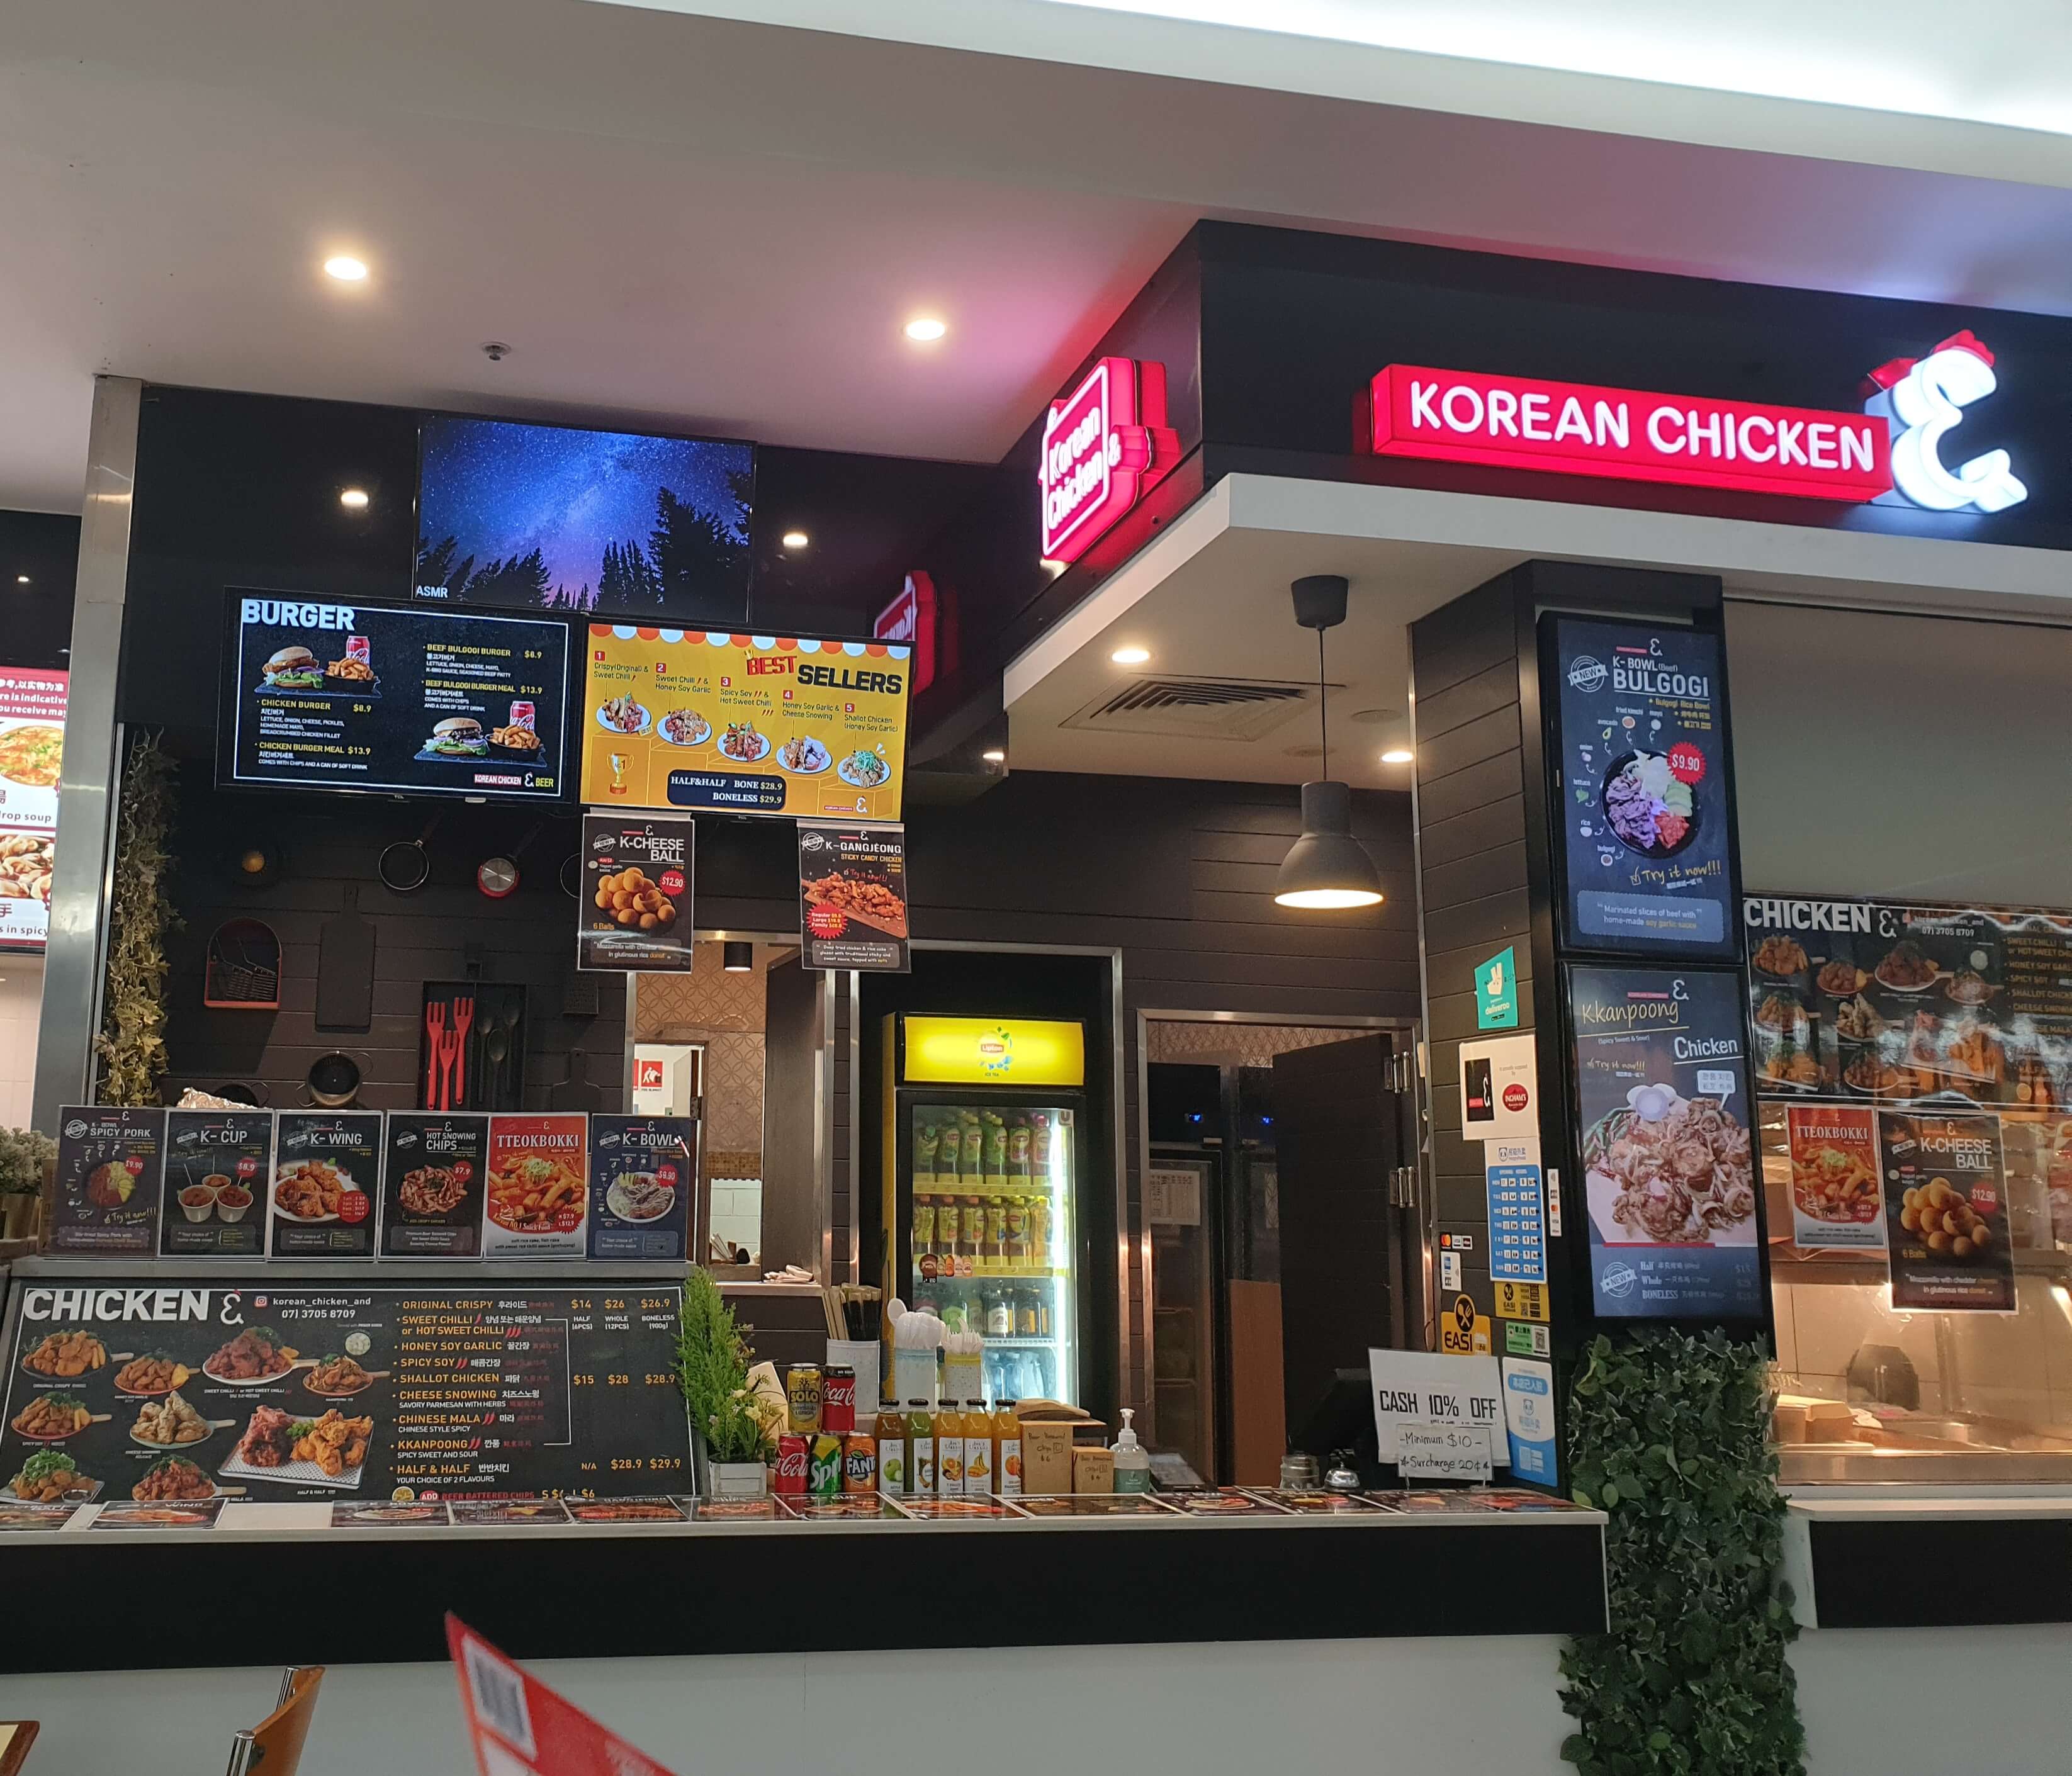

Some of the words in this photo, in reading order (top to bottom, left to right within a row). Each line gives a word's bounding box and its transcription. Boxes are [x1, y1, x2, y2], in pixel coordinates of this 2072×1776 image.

[1411, 381, 1630, 448] KOREAN
[1647, 407, 1874, 473] CHICKEN
[1049, 407, 1100, 485] Korean
[1047, 451, 1102, 529] Chicken
[415, 585, 448, 598] ASMR
[242, 600, 355, 631] BURGER
[448, 646, 480, 654] BULGOGI
[481, 648, 511, 656] BURGER
[524, 650, 542, 659] $8.9
[1628, 658, 1658, 671] BOWL
[746, 655, 797, 675] BEST
[797, 665, 902, 695] SELLERS
[443, 681, 470, 689] BULGOGI
[471, 683, 497, 691] BURGER
[521, 685, 543, 694] $13.9
[1613, 669, 1708, 697] BULGOGI
[678, 685, 690, 693] Soy
[720, 688, 738, 697] Spicy
[12, 705, 47, 714] receive
[262, 699, 296, 707] CHICKEN
[298, 702, 330, 710] BURGER
[353, 704, 371, 712] $8.9
[806, 712, 832, 720] Snowing
[259, 742, 291, 750] CHICKEN
[293, 744, 323, 752] BURGER
[347, 746, 371, 755] $13.9
[1672, 755, 1699, 771] $9.90
[536, 778, 553, 787] BEER
[670, 775, 726, 787] HALF&HALF
[734, 780, 759, 789] BONE
[760, 781, 782, 791] $28.9
[712, 792, 758, 803] BONELESS
[760, 794, 782, 804] $29.9
[25, 814, 51, 823] soup
[620, 836, 684, 851] K-CHEESE
[826, 841, 901, 853] K-GANGJEONG
[651, 851, 684, 862] BALL
[662, 877, 684, 888] $12.90
[1641, 870, 1665, 884] Try
[1743, 899, 1871, 933] CHICKEN
[7, 925, 16, 933] in
[21, 926, 48, 936] spicy
[1582, 1001, 1679, 1028] Kkanpoong
[1674, 1037, 1738, 1059] Chicken
[90, 1128, 120, 1137] SPICY
[125, 1128, 151, 1137] PORK
[221, 1131, 247, 1143] CUP
[1795, 1126, 1869, 1140] TTEOKBOKKI
[329, 1133, 363, 1145] WING
[497, 1135, 580, 1148] TTEOKBOKKI
[640, 1135, 675, 1146] BOWL
[426, 1140, 458, 1150] CHIPS
[1920, 1138, 1992, 1154] K-CHEESE
[1956, 1155, 1993, 1169] BALL
[455, 1166, 470, 1176] $7.9
[24, 1289, 210, 1321] CHICKEN
[273, 1297, 371, 1307] korean_chicken_and
[403, 1301, 453, 1309] ORIGINAL
[456, 1301, 493, 1309] CRISPY
[498, 1300, 527, 1309] 후라이드
[571, 1299, 591, 1309] $14
[605, 1299, 624, 1309] $26
[641, 1298, 670, 1309] $26.9
[301, 1309, 327, 1319] 3705
[330, 1309, 356, 1318] 8709
[402, 1315, 437, 1324] SWEET
[440, 1315, 473, 1324] CHILLI
[485, 1315, 499, 1324] 양념
[500, 1315, 514, 1324] 또는
[515, 1315, 541, 1324] 매운양념
[417, 1327, 436, 1335] HOT
[438, 1327, 471, 1335] SWEET
[402, 1342, 438, 1351] HONEY
[441, 1342, 461, 1351] SOY
[464, 1342, 502, 1350] GARLIC
[507, 1342, 529, 1350] 꿀간장
[1445, 1332, 1472, 1351] EASI
[401, 1358, 432, 1366] SPICY
[435, 1358, 455, 1366] SOY
[471, 1358, 500, 1368] 매콤간장
[400, 1374, 449, 1383] SHALLOT
[452, 1374, 499, 1383] CHICKEN
[505, 1374, 520, 1383] 파닭
[574, 1375, 594, 1385] $15
[608, 1374, 628, 1385] $28
[645, 1374, 675, 1385] $28.9
[400, 1391, 442, 1400] CHEESE
[445, 1390, 497, 1399] SNOWING
[502, 1389, 539, 1399] 치즈스노윙
[791, 1391, 818, 1402] SOLO
[1380, 1390, 1419, 1413] CASH
[1429, 1394, 1459, 1416] 10%
[1470, 1397, 1497, 1419] OFF
[399, 1415, 446, 1424] CHINESE
[450, 1415, 480, 1423] MALA
[500, 1414, 514, 1423] 마라
[398, 1440, 468, 1449] KKANPOONG
[484, 1439, 500, 1448] 깐풍
[1447, 1433, 1472, 1447] $10
[478, 1464, 509, 1473] 반반치킨
[611, 1459, 642, 1470] $28.9
[650, 1458, 680, 1470] $29.9
[846, 1456, 876, 1473] FANT
[1410, 1454, 1455, 1472] Surcharge
[397, 1465, 427, 1474] HALF
[441, 1464, 471, 1473] HALF
